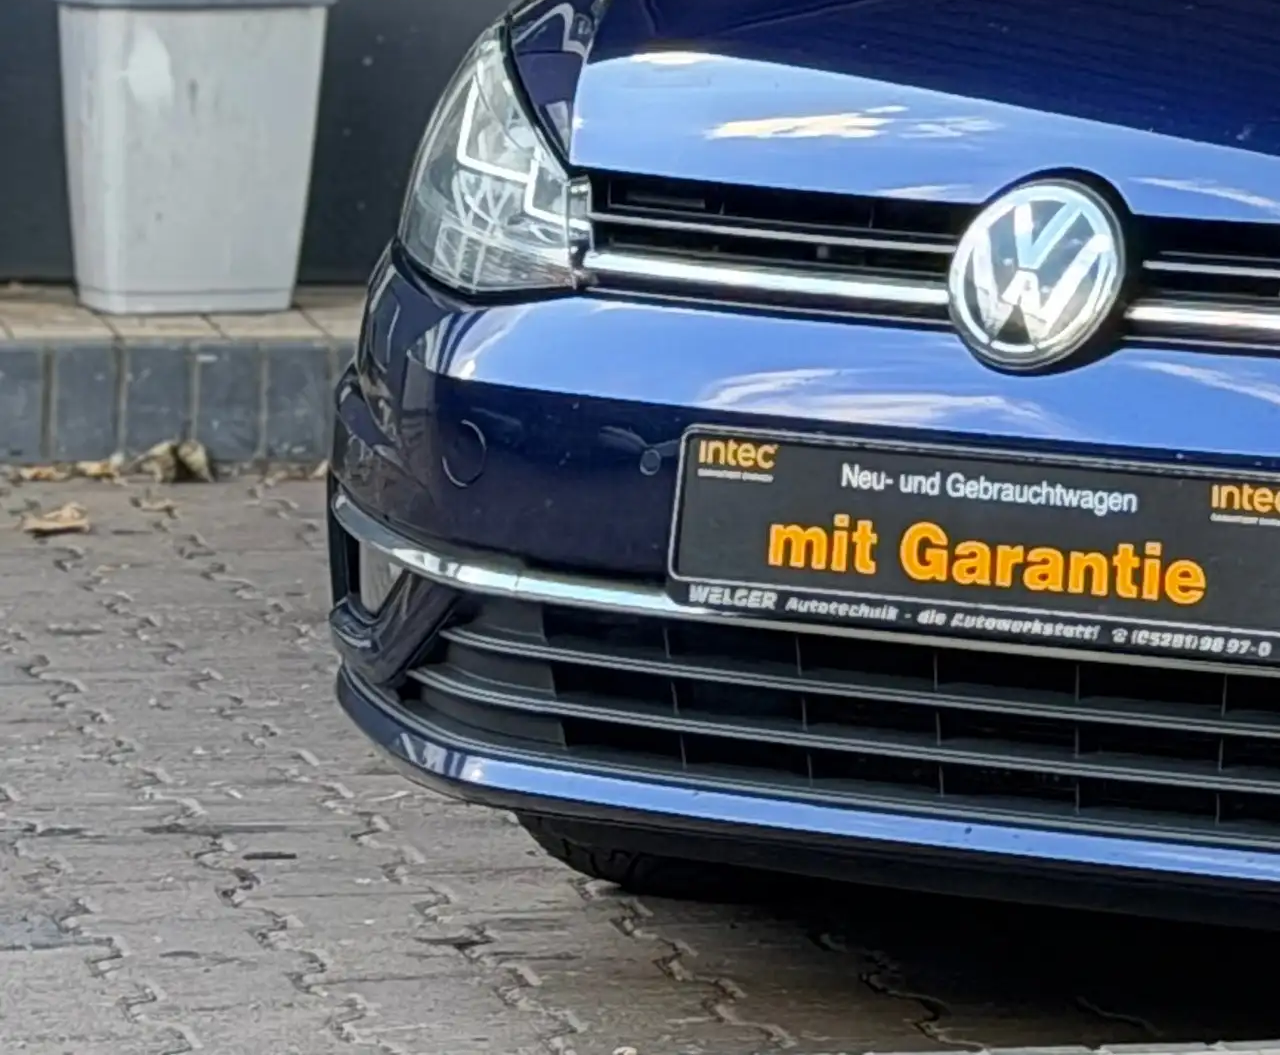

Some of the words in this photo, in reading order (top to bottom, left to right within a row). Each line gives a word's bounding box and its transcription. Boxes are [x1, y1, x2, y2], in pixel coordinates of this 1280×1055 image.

[699, 439, 777, 469] intec
[841, 462, 893, 491] Neu-
[900, 472, 940, 496] und
[946, 472, 1138, 517] Gebrauchtwagen
[768, 513, 878, 575] mit
[900, 521, 1207, 605] Garantie
[688, 584, 778, 610] WELGER
[785, 597, 899, 622] Autotechnik
[917, 609, 947, 626] die
